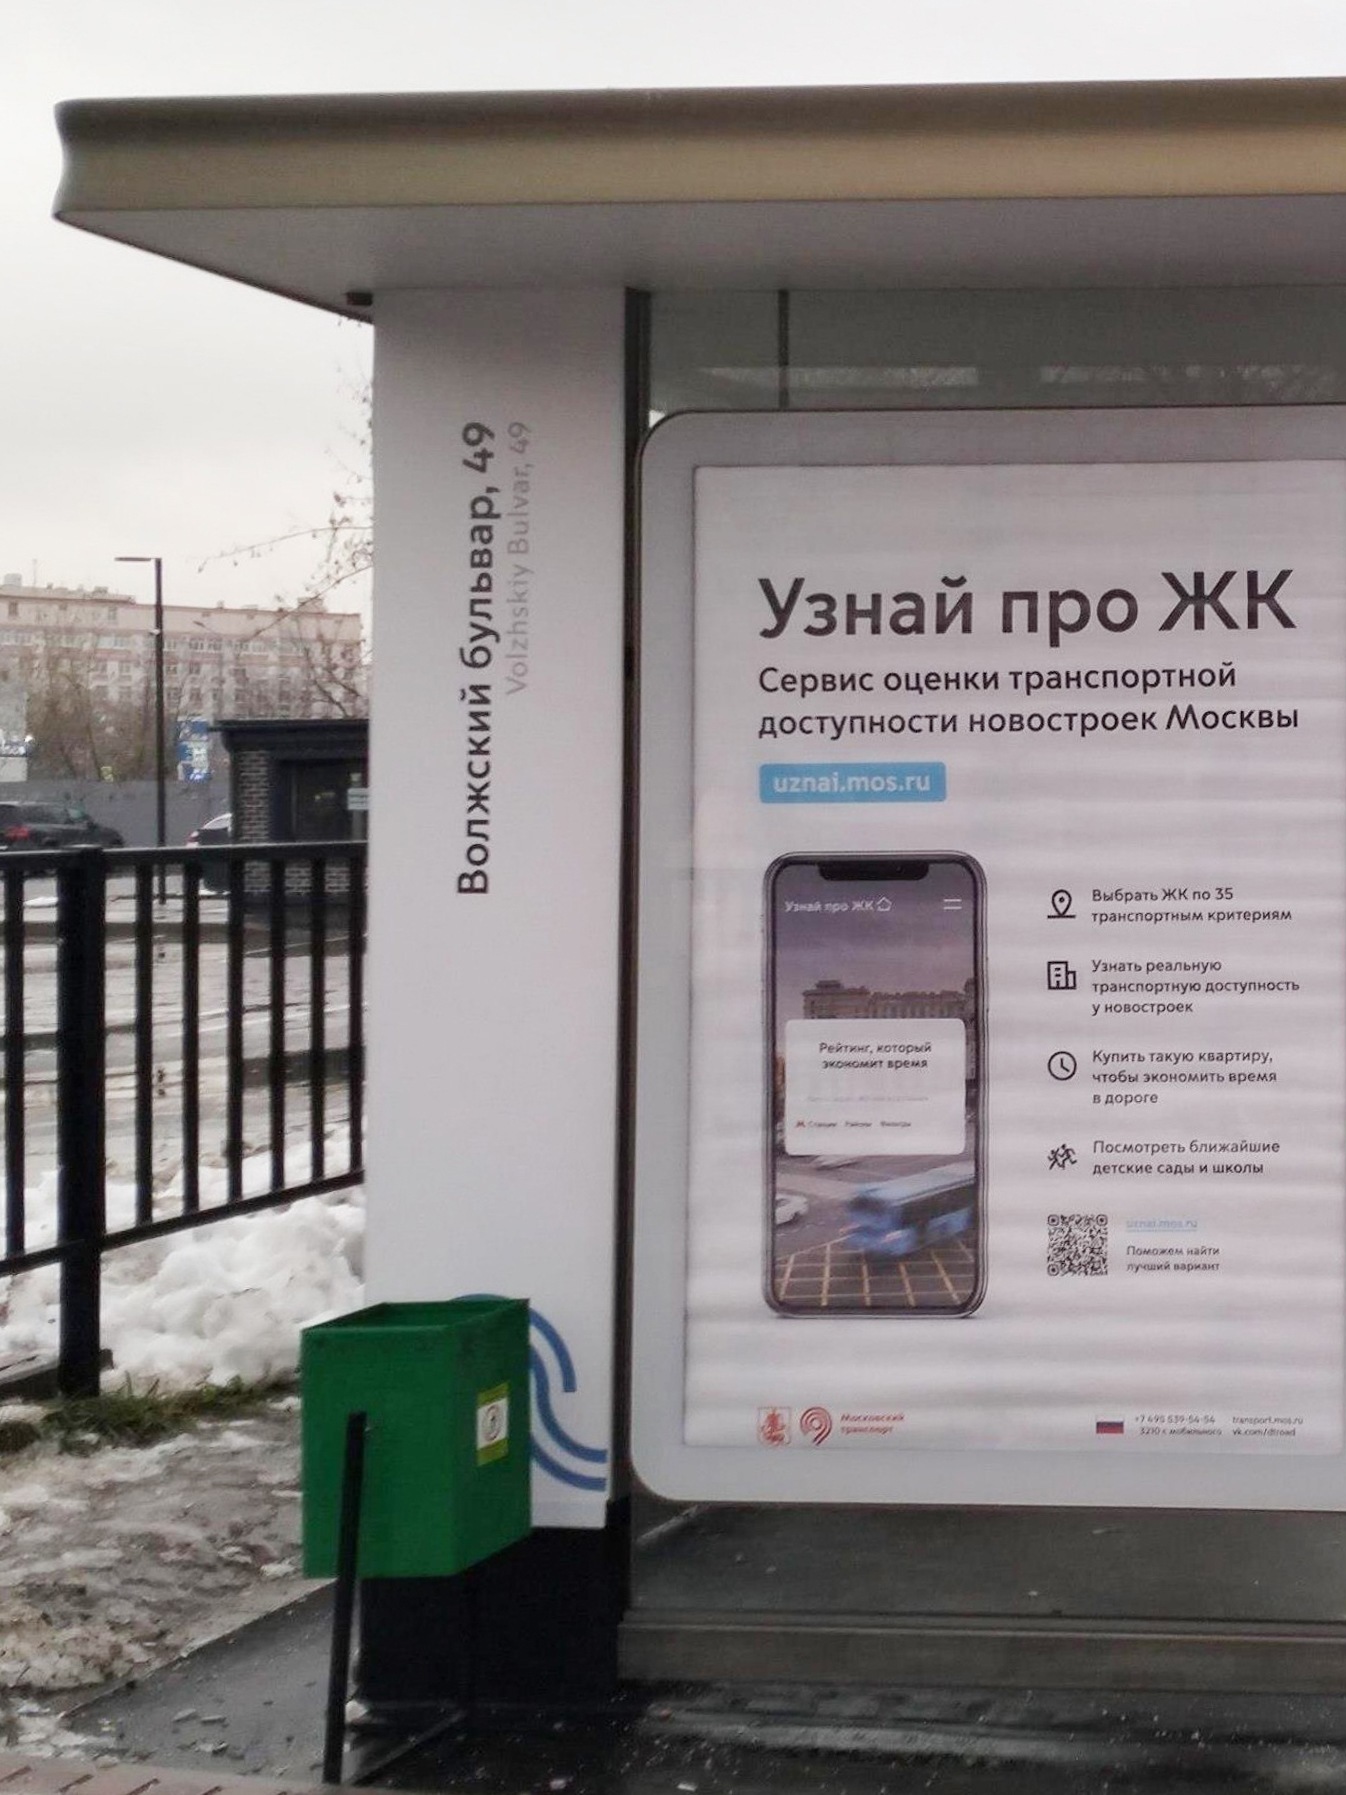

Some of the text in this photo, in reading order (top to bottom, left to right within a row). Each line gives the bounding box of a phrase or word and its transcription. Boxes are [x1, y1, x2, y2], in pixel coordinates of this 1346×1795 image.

[507, 421, 536, 696] Volzhskiy Bulvar, 49
[757, 569, 1297, 648] Узнай про ЖК
[457, 422, 502, 895] Волжский бульвар, 49
[758, 661, 1236, 697] Сервис оценки транспортной
[758, 703, 1299, 742] доступности новостроек Москвы
[774, 772, 930, 797] uznai.mos.ru
[1092, 887, 1234, 904] Выбрать ЖК по 35
[851, 899, 875, 912] ЖК
[1091, 909, 1293, 925] транспортным критериям
[1091, 959, 1223, 974] Узнать реальную
[1092, 979, 1301, 995] транспортную доступность
[1091, 1001, 1194, 1016] у новостроек
[819, 1041, 932, 1056] Рейтинг, который
[822, 1059, 928, 1071] экономит время
[1092, 1050, 1274, 1065] Купить такую квартиру,
[1092, 1070, 1278, 1085] чтобы экономить время
[1092, 1092, 1159, 1107] в дороге
[1092, 1139, 1281, 1156] Посмотреть ближайшие
[1092, 1162, 1265, 1175] детские сады и школы
[1126, 1244, 1221, 1257] Поможем найти
[1125, 1261, 1220, 1273] лучший вариант
